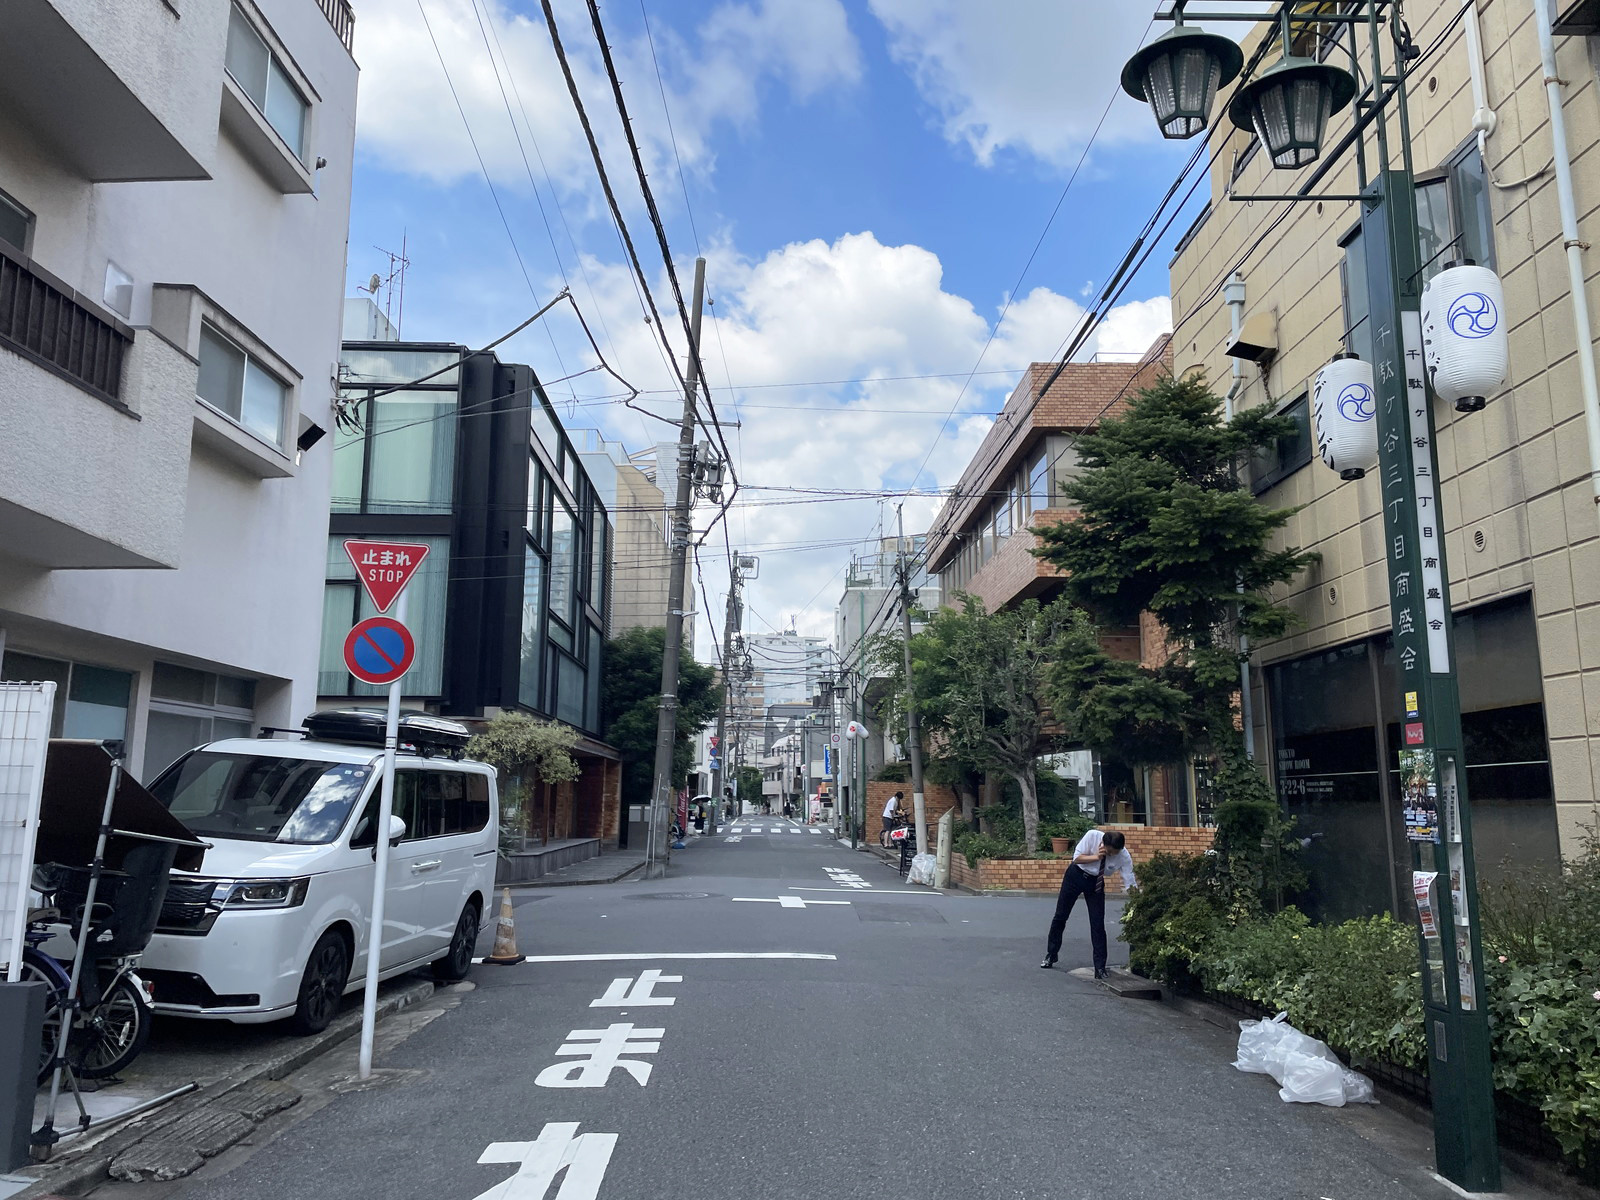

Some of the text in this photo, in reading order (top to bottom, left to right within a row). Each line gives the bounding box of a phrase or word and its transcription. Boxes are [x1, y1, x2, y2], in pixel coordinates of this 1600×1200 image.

[361, 549, 411, 566] 止まれ
[369, 569, 404, 583] STOP
